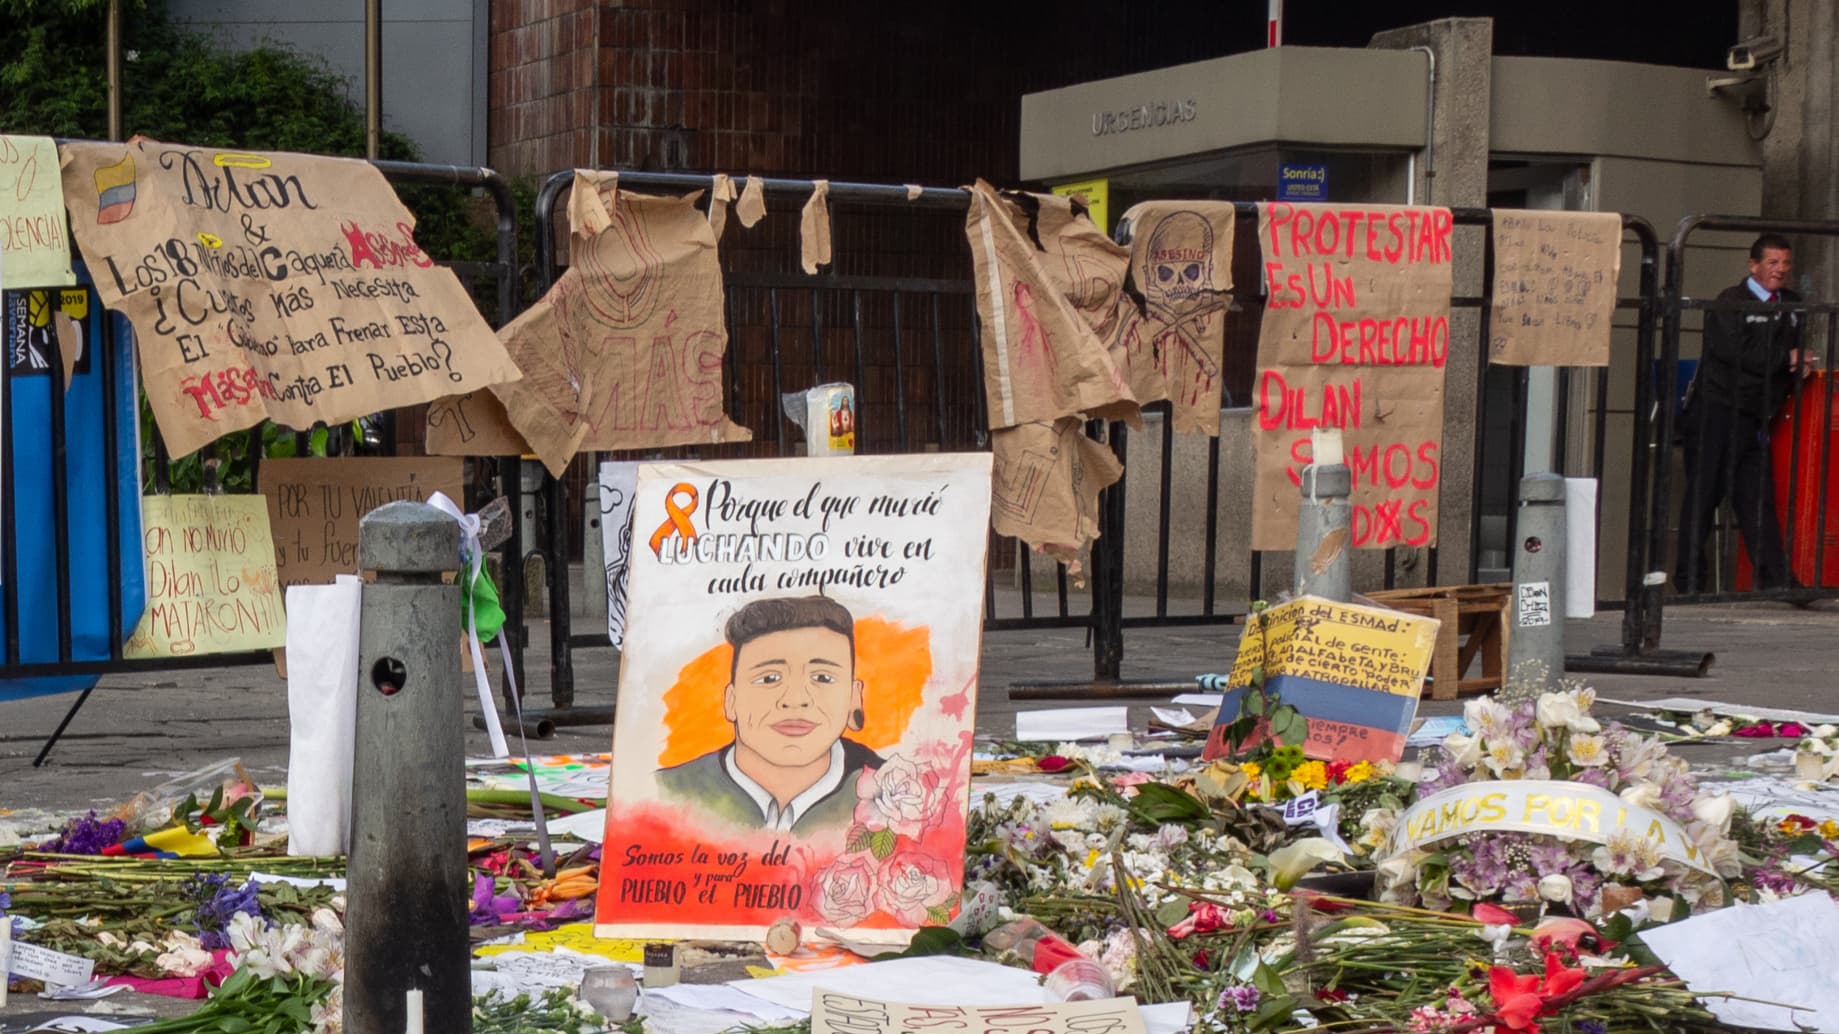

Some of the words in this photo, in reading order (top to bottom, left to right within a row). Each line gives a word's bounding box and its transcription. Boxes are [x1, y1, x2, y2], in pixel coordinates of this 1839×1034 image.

[1092, 98, 1197, 137] URGENCIAS
[1266, 201, 1454, 264] PROTESTAR
[103, 254, 168, 297] Los
[331, 276, 422, 304] Necesita
[16, 297, 27, 364] SEMANA
[175, 334, 210, 365] El
[328, 316, 393, 346] Frenar
[394, 312, 449, 344] Esta
[1311, 312, 1448, 367] DERECHO
[326, 363, 355, 390] El
[1259, 370, 1361, 431] DILAN
[1285, 437, 1440, 493] SMOS
[277, 483, 310, 519] POR
[318, 483, 342, 520] TU
[704, 477, 788, 539] Porque
[793, 480, 822, 520] el
[818, 494, 861, 535] que
[867, 483, 950, 520] murió
[658, 531, 831, 566] LUCHANDO
[842, 536, 895, 563] vive
[902, 534, 936, 562] en
[706, 562, 768, 595] cada
[776, 564, 909, 601] compañero
[1325, 636, 1347, 650] de
[1407, 793, 1508, 842] VAMOS
[1522, 793, 1601, 833] POR
[621, 839, 684, 869] Somos
[690, 841, 712, 866] la
[715, 850, 749, 879] voz
[761, 838, 792, 868] del
[620, 881, 688, 906] PUEBLO
[697, 879, 718, 905] el
[733, 881, 804, 912] PUEBLO
